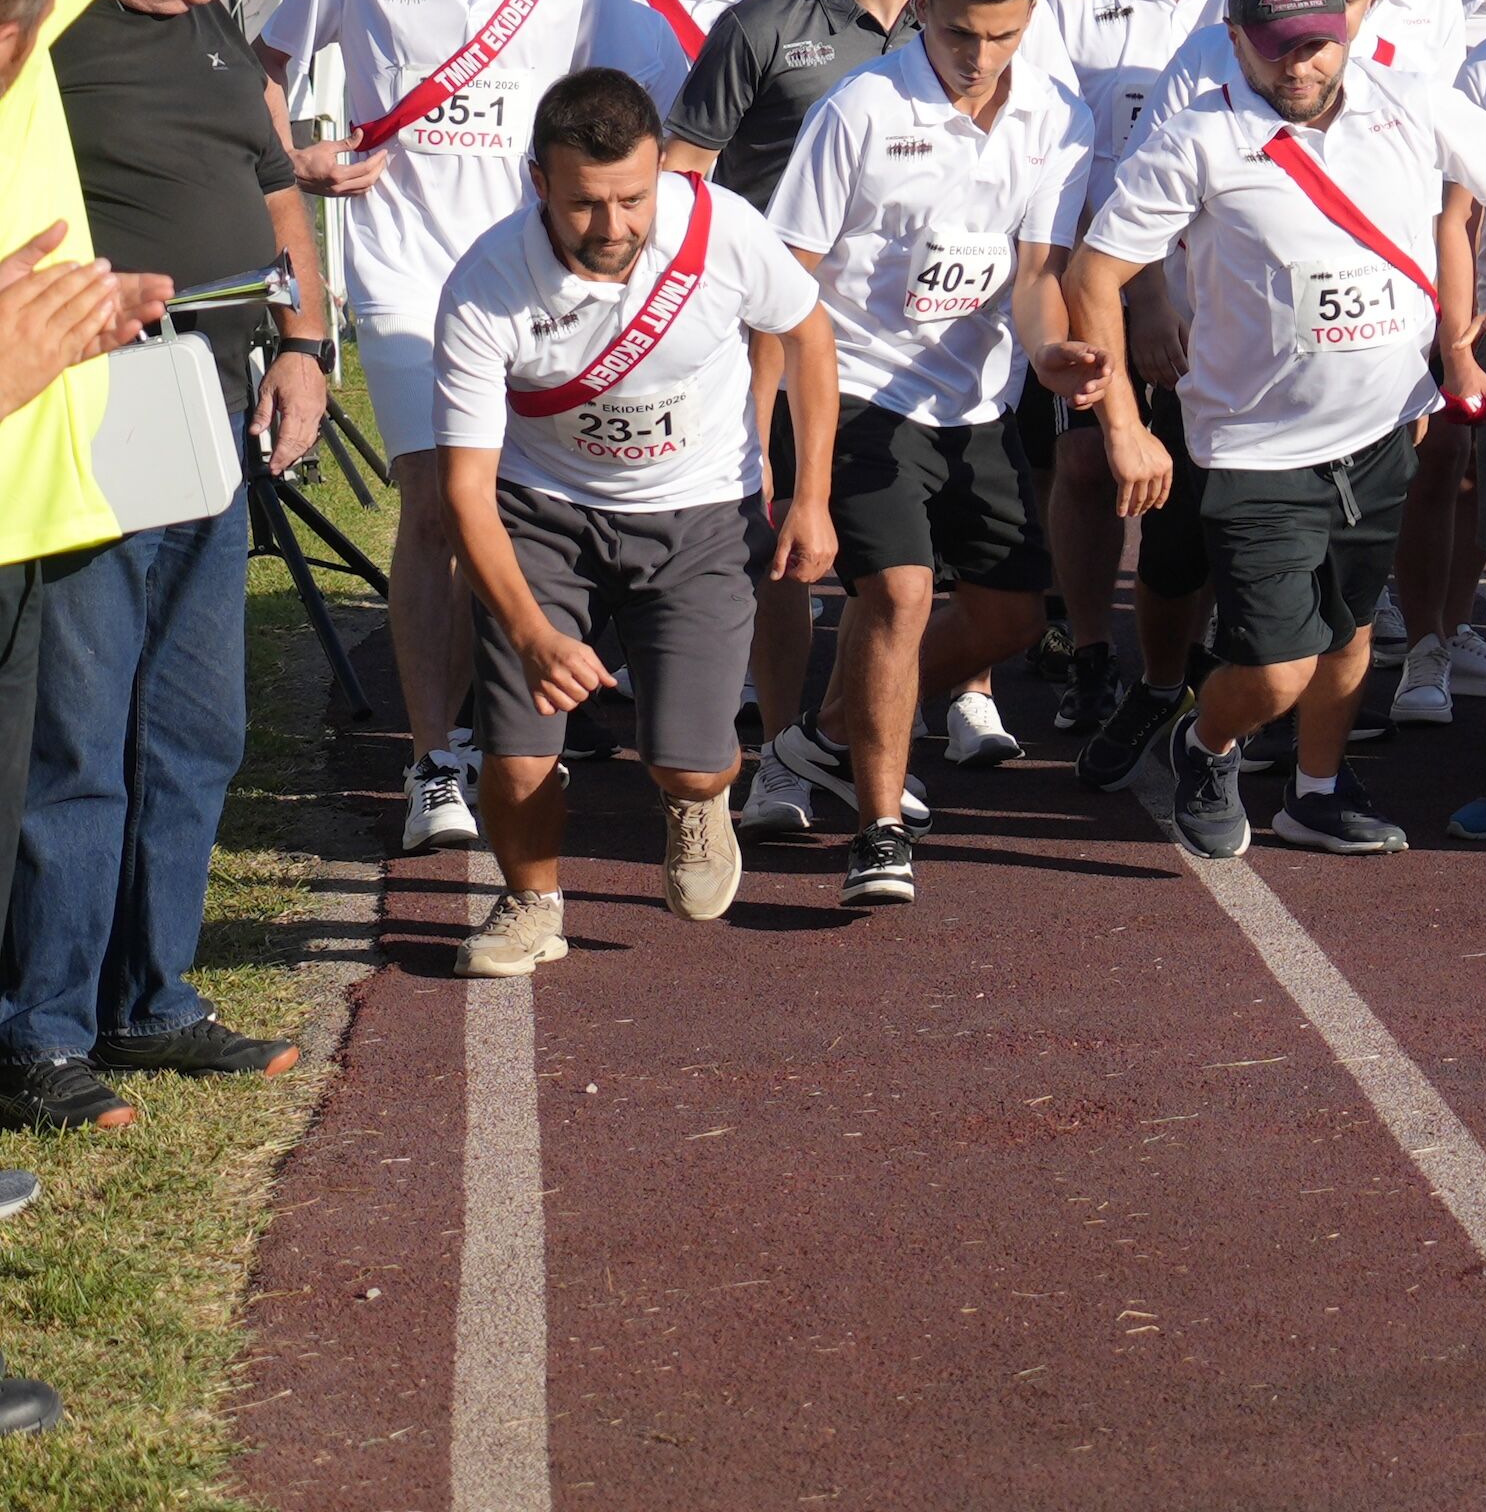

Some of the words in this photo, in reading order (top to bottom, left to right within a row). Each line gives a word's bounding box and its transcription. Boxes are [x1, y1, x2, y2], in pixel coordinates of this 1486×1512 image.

[433, 43, 490, 93] TMMT
[466, 79, 492, 89] DEN
[495, 80, 520, 90] 2026
[414, 129, 503, 148] TOYOTA
[949, 246, 985, 255] EKIDEN
[987, 245, 1008, 255] 2026
[917, 261, 996, 292] 40-1
[1339, 265, 1378, 280] EKIDEN
[641, 271, 698, 334] TMMT
[906, 291, 980, 313] TOYOTA
[1319, 278, 1396, 321] 53-1
[1311, 318, 1400, 344] TOYOTA
[602, 403, 654, 414] EKIDEN
[659, 392, 687, 409] 2026
[578, 411, 674, 442] 23-1
[572, 436, 677, 460] TOYOTA
[680, 438, 687, 448] 1
